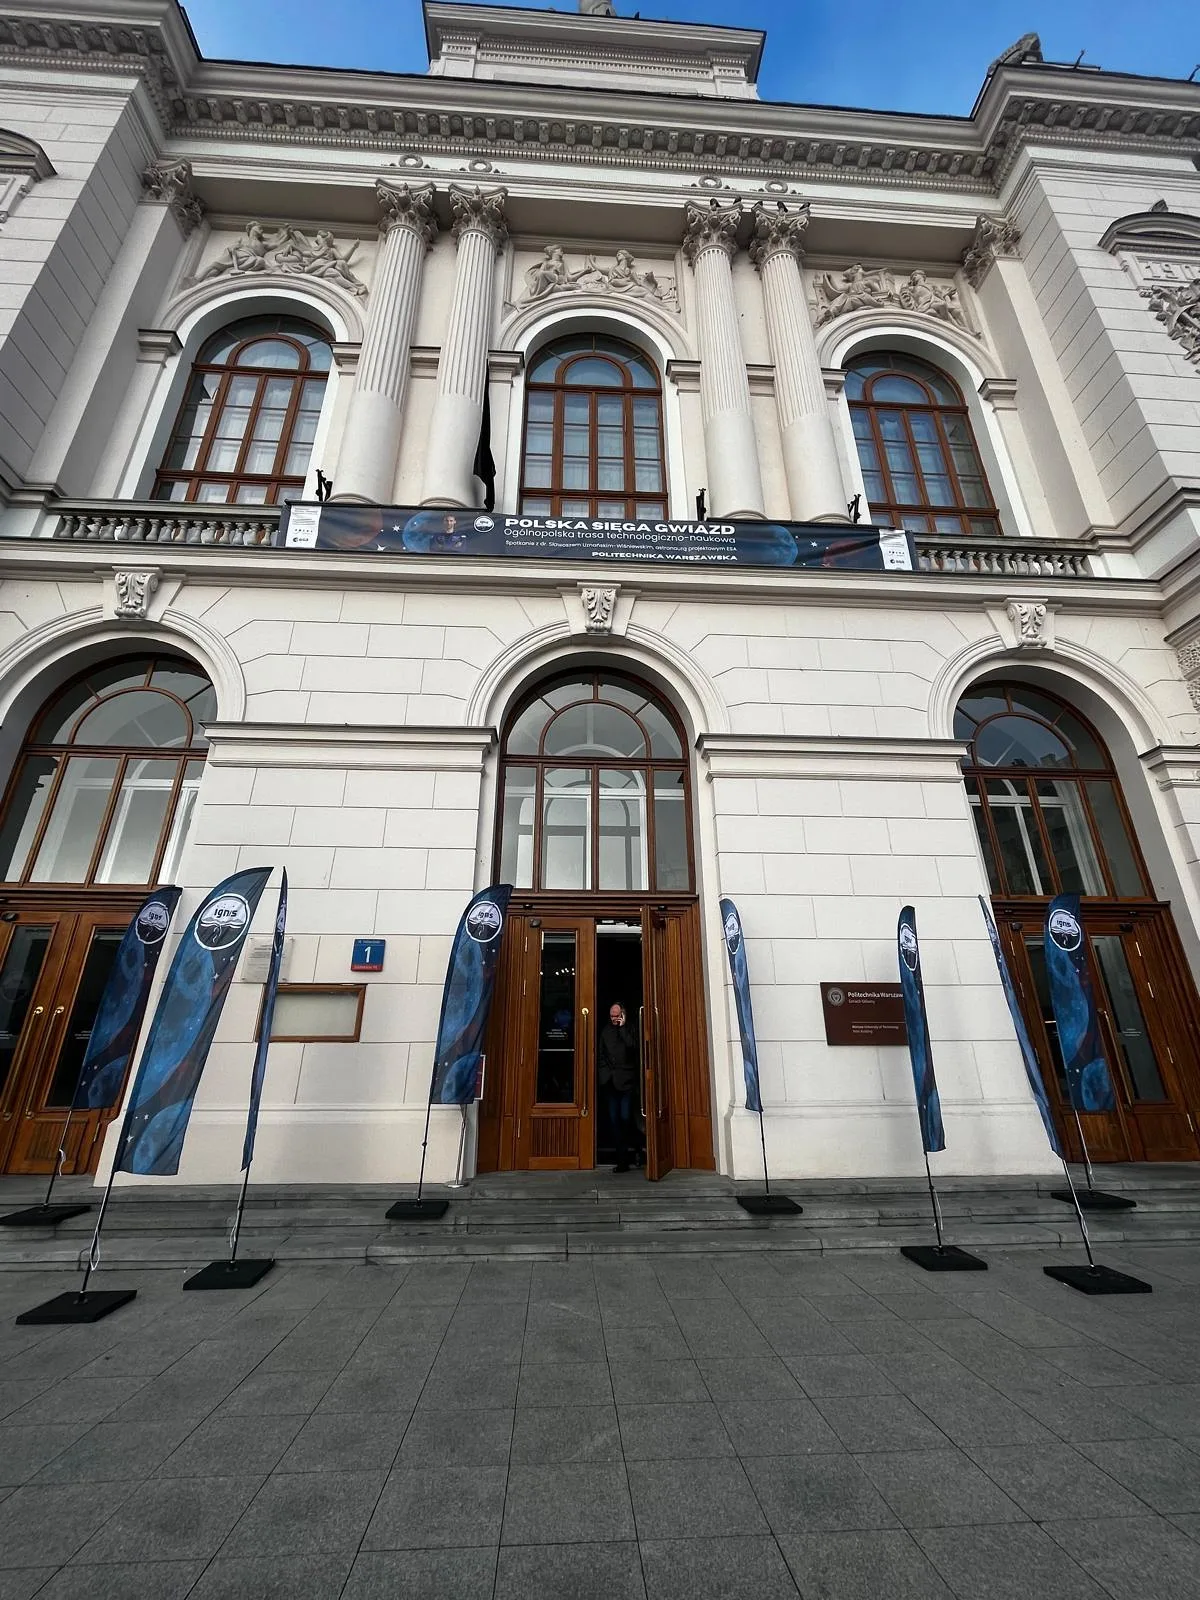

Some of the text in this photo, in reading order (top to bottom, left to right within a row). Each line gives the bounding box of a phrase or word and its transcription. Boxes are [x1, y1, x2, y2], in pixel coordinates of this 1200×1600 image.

[504, 518, 736, 535] POLSKA SIĘGA GWIAZD
[503, 527, 736, 544] Ogólnopolska trasa technologiczno-naukowa
[591, 551, 738, 561] POLITECHNIKA WARSZAWSKA
[364, 946, 372, 963] 1
